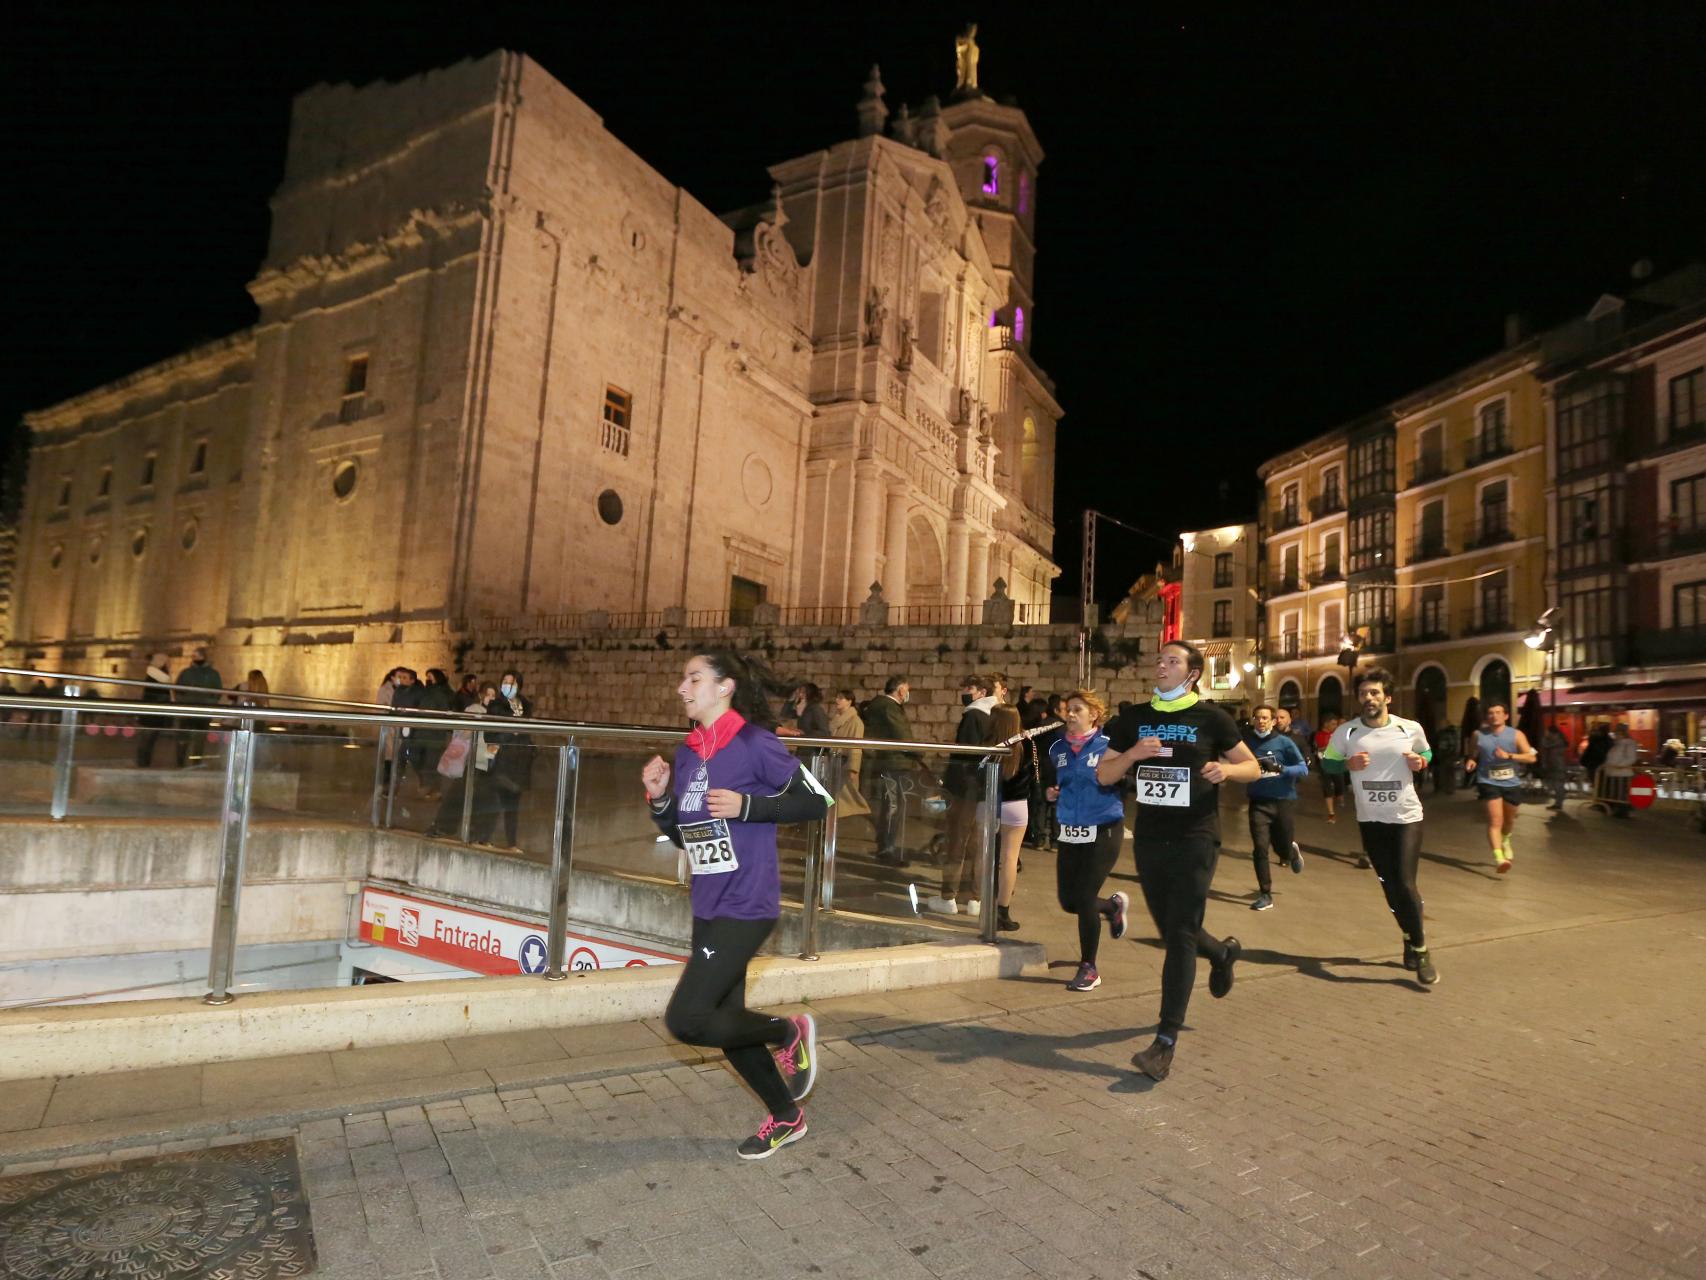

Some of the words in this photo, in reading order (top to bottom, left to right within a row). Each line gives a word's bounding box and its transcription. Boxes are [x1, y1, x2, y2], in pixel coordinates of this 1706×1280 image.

[1138, 724, 1198, 734] CLASSY
[1144, 782, 1181, 799] 237
[1368, 791, 1397, 802] 266
[1065, 825, 1090, 838] 655
[433, 919, 501, 956] Entrada
